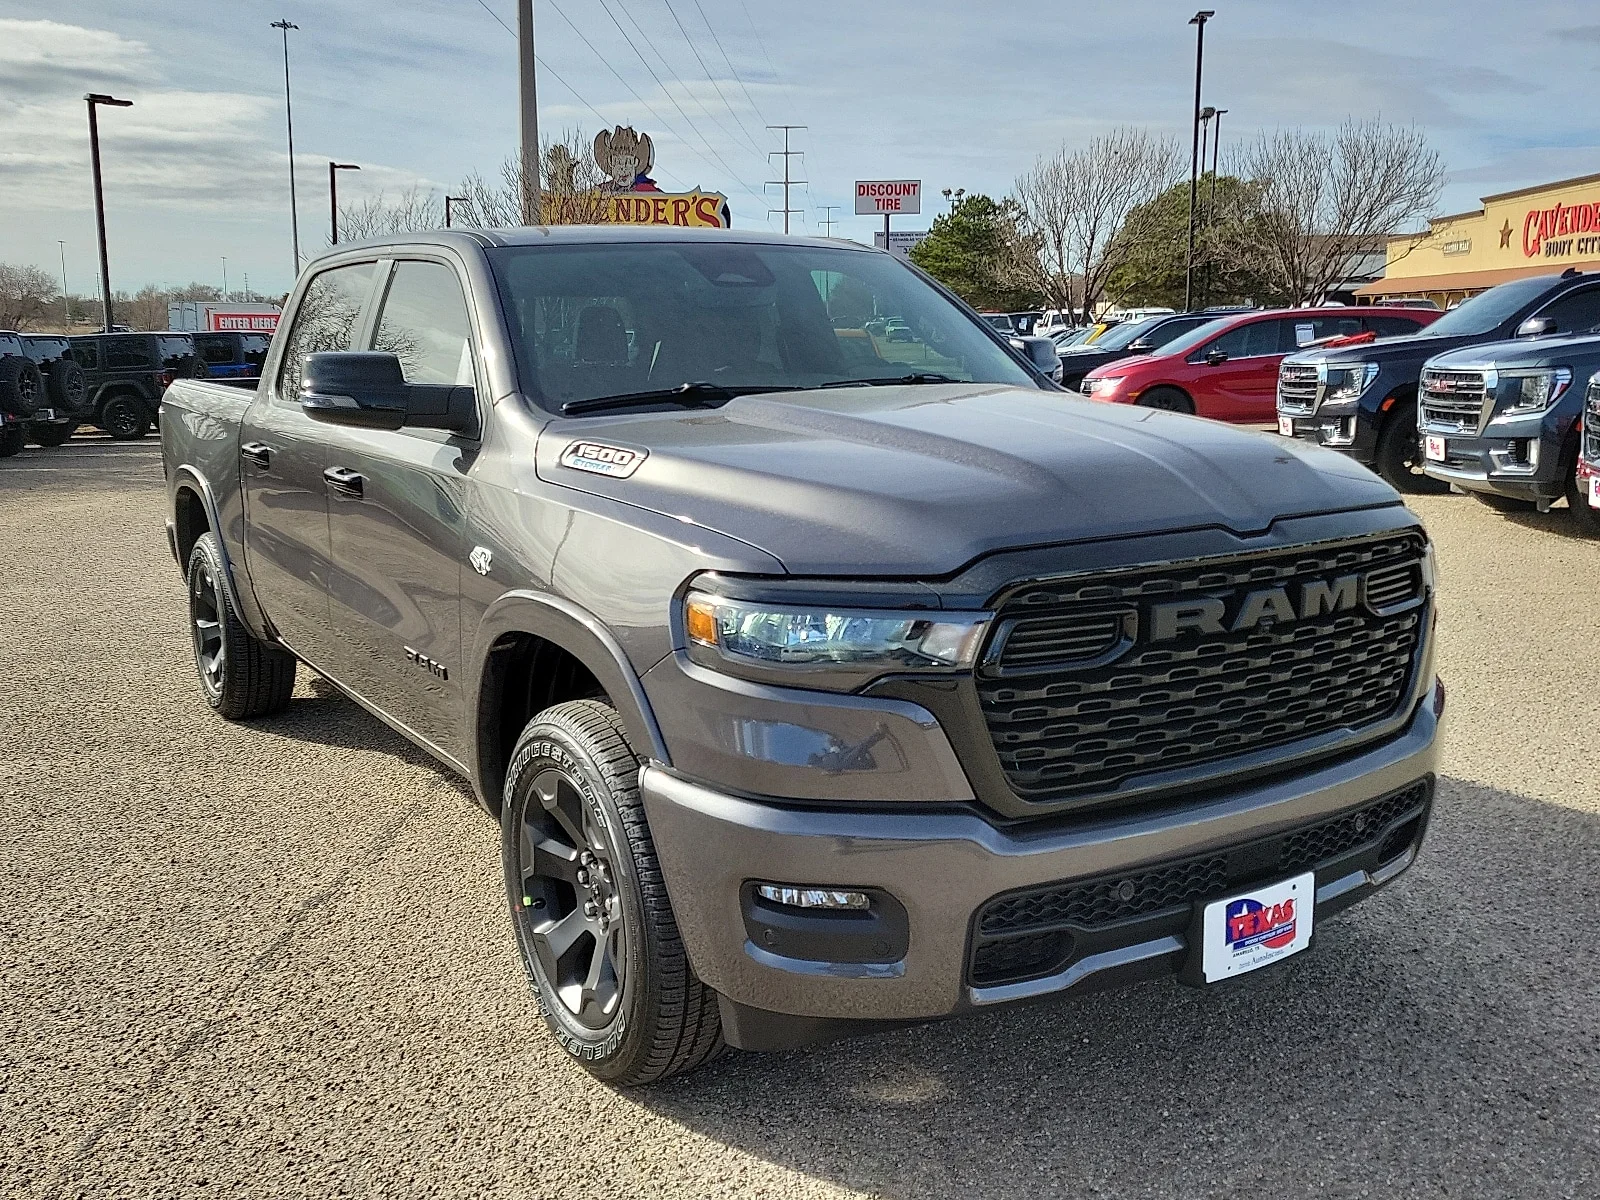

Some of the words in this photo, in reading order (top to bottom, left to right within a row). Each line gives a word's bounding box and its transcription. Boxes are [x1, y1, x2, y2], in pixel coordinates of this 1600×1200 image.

[858, 184, 918, 196] DISCOUNT
[875, 198, 901, 210] TIRE
[219, 317, 251, 330] ENTER
[252, 317, 277, 329] HERE
[577, 443, 635, 466] 1500
[1151, 573, 1359, 642] RAM
[505, 742, 607, 828] BRIDGESTONE
[1229, 898, 1295, 940] TEXAS
[555, 1008, 626, 1060] DUELER
